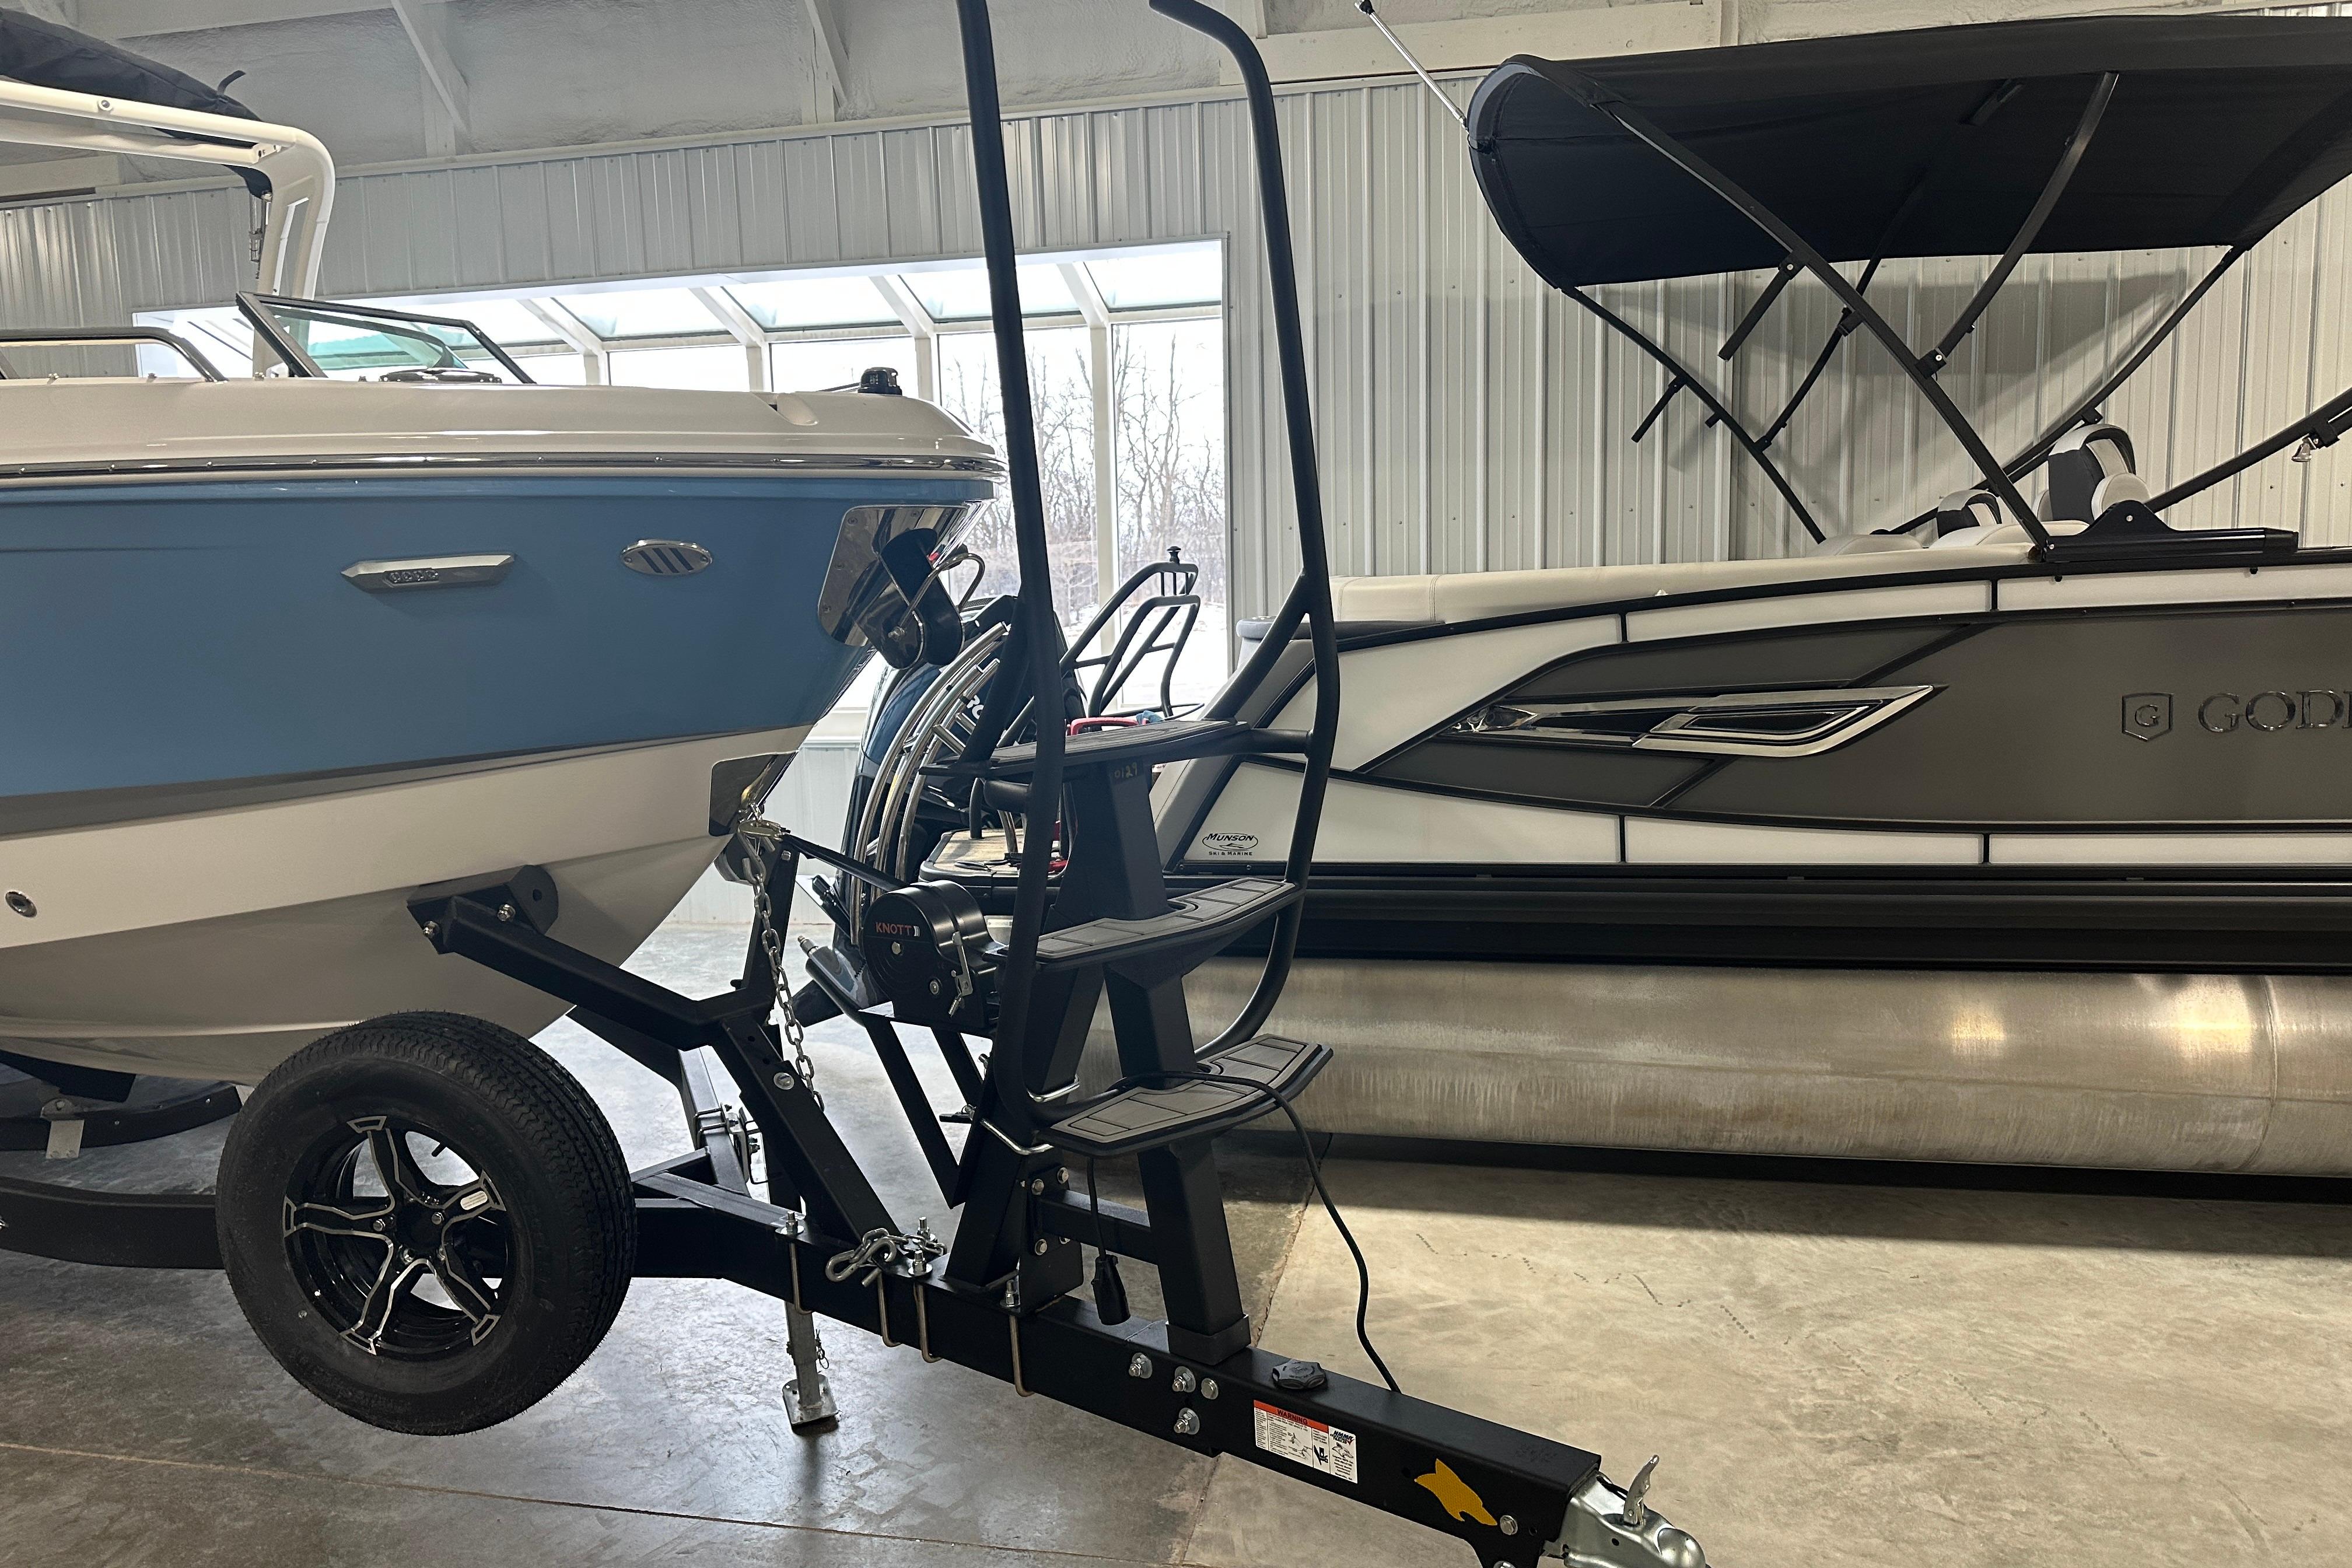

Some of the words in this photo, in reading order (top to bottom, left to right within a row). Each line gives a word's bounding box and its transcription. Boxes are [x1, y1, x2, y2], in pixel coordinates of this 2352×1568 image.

[1206, 833, 1255, 841] MUNSON
[876, 922, 912, 936] KNOTT
[1276, 1409, 1308, 1426] WARNING
